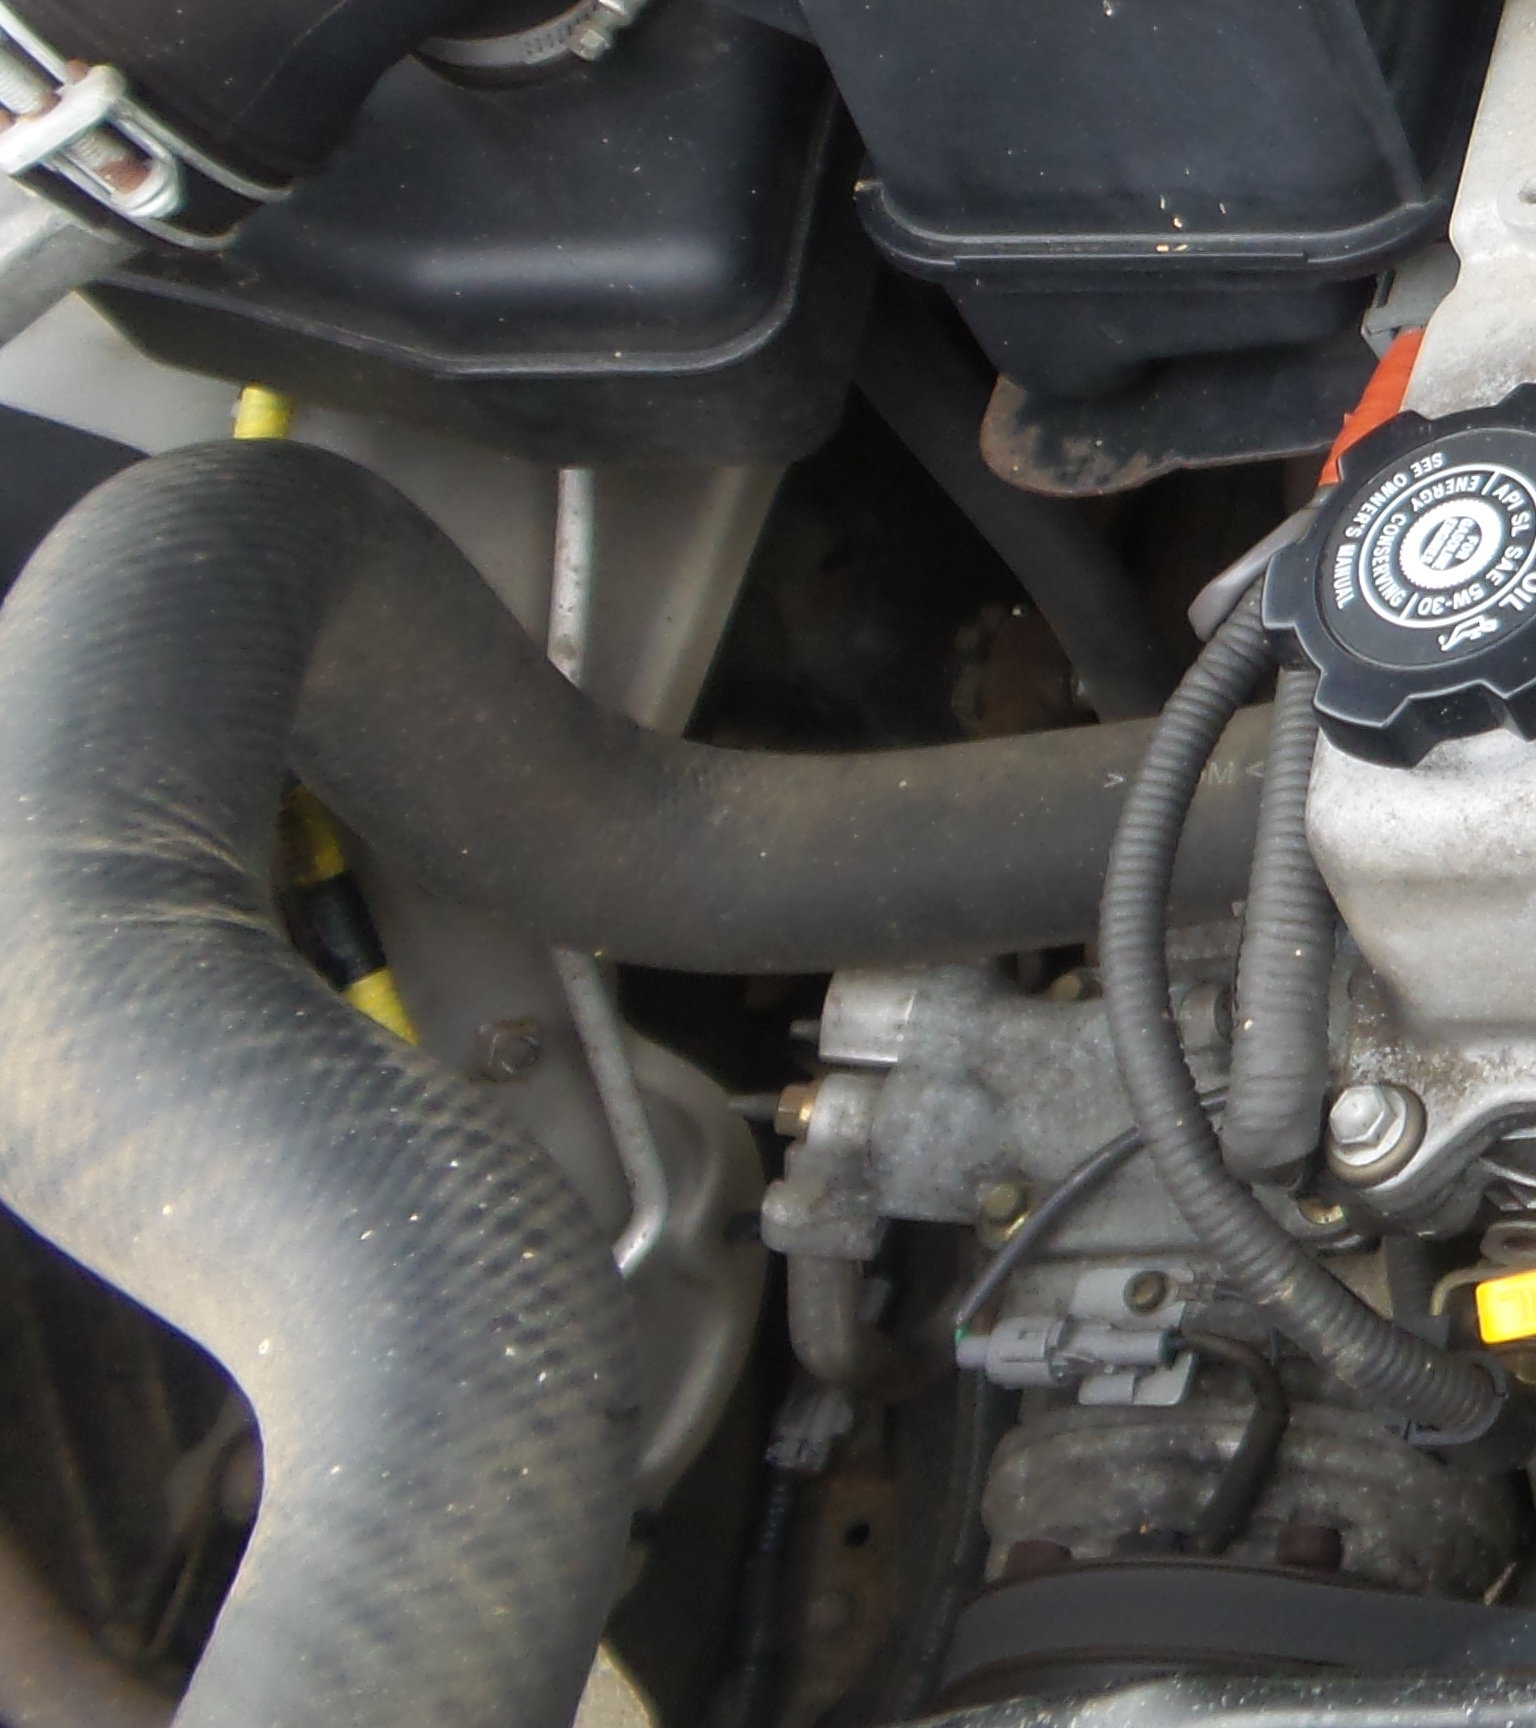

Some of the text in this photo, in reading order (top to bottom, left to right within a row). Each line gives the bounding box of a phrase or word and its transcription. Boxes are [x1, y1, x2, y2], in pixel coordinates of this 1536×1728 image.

[1333, 452, 1445, 609] SEE OWNER'S MANUAL
[1372, 474, 1484, 609] ENERGY CONSERVING
[1417, 483, 1531, 617] API SL SAE 5W-30
